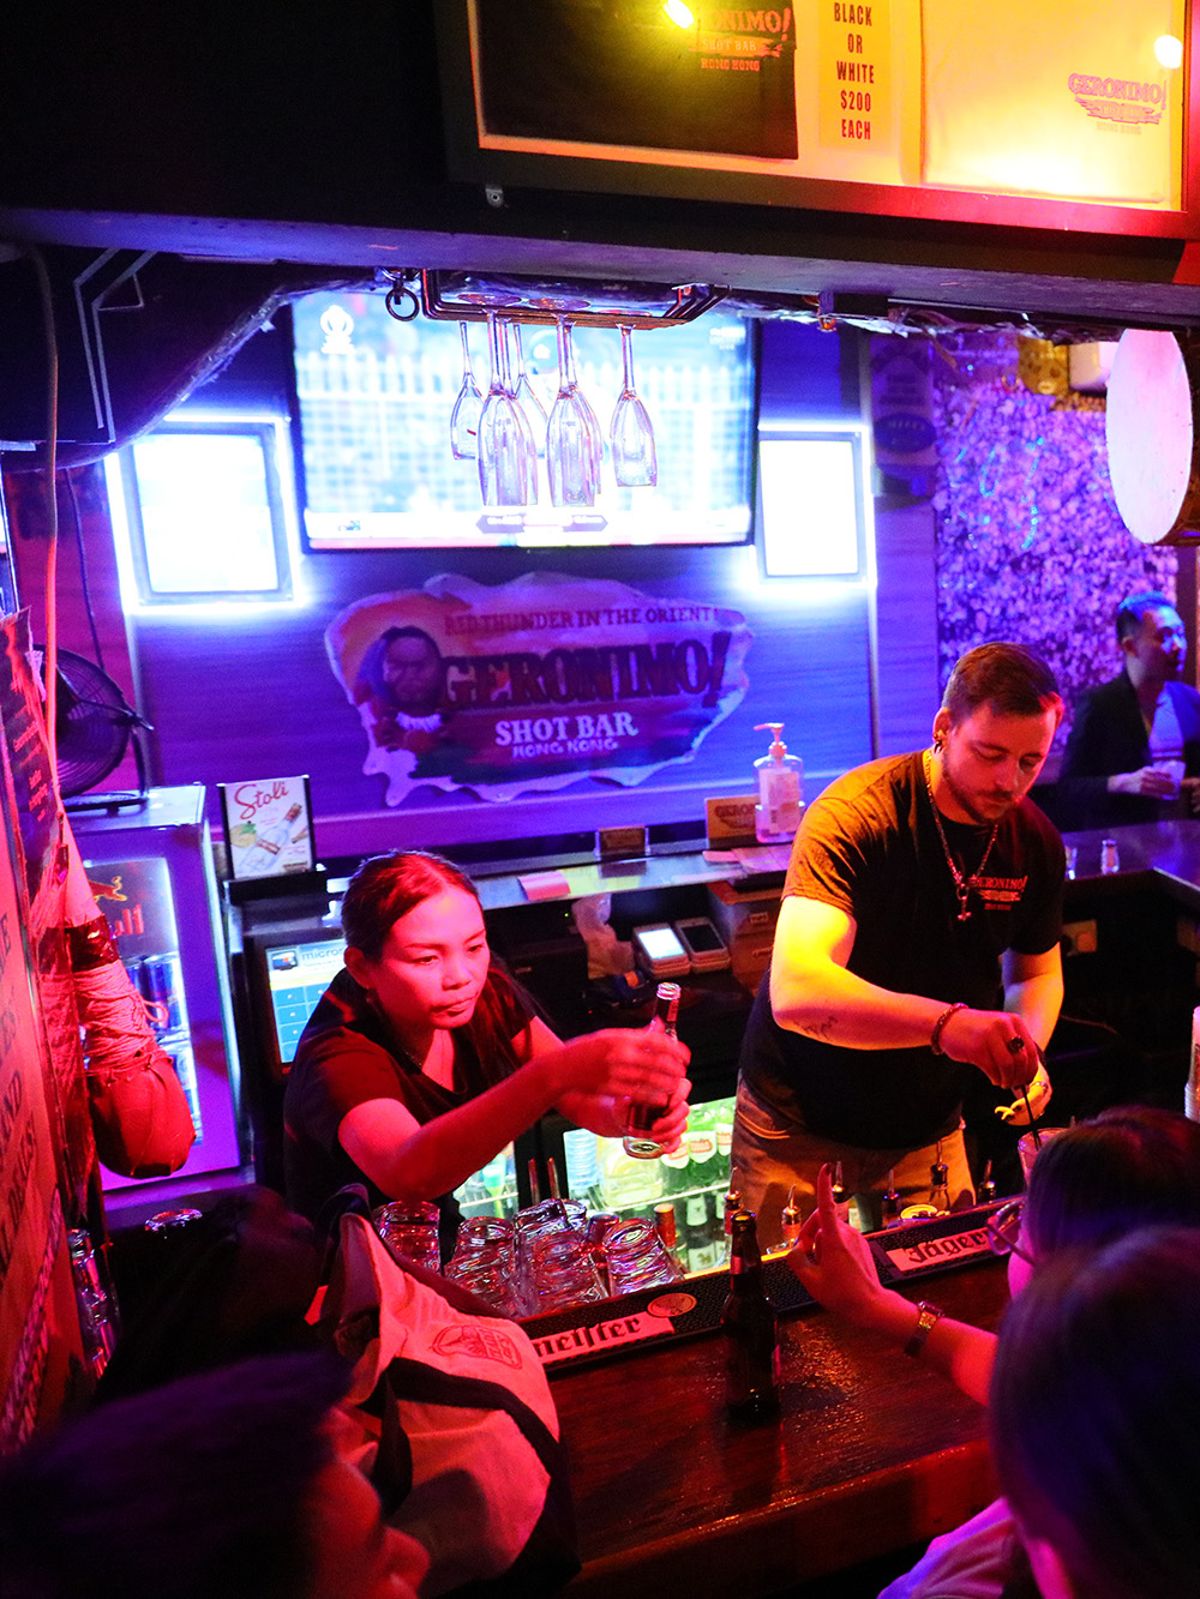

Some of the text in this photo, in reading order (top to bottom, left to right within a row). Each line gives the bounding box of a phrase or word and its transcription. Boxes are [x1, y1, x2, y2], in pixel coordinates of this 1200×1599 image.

[834, 2, 872, 26] BLACK
[848, 33, 863, 54] OR
[701, 58, 760, 72] HONG KONG
[836, 60, 874, 84] WHITE
[841, 90, 871, 112] $200
[841, 119, 871, 140] EACH
[576, 609, 600, 627] IN
[601, 608, 641, 625] THE
[440, 631, 732, 709] GERONIMO!
[495, 711, 639, 746] SHOT BAR
[512, 737, 618, 758] HONG KONG
[234, 781, 289, 820] Stoli
